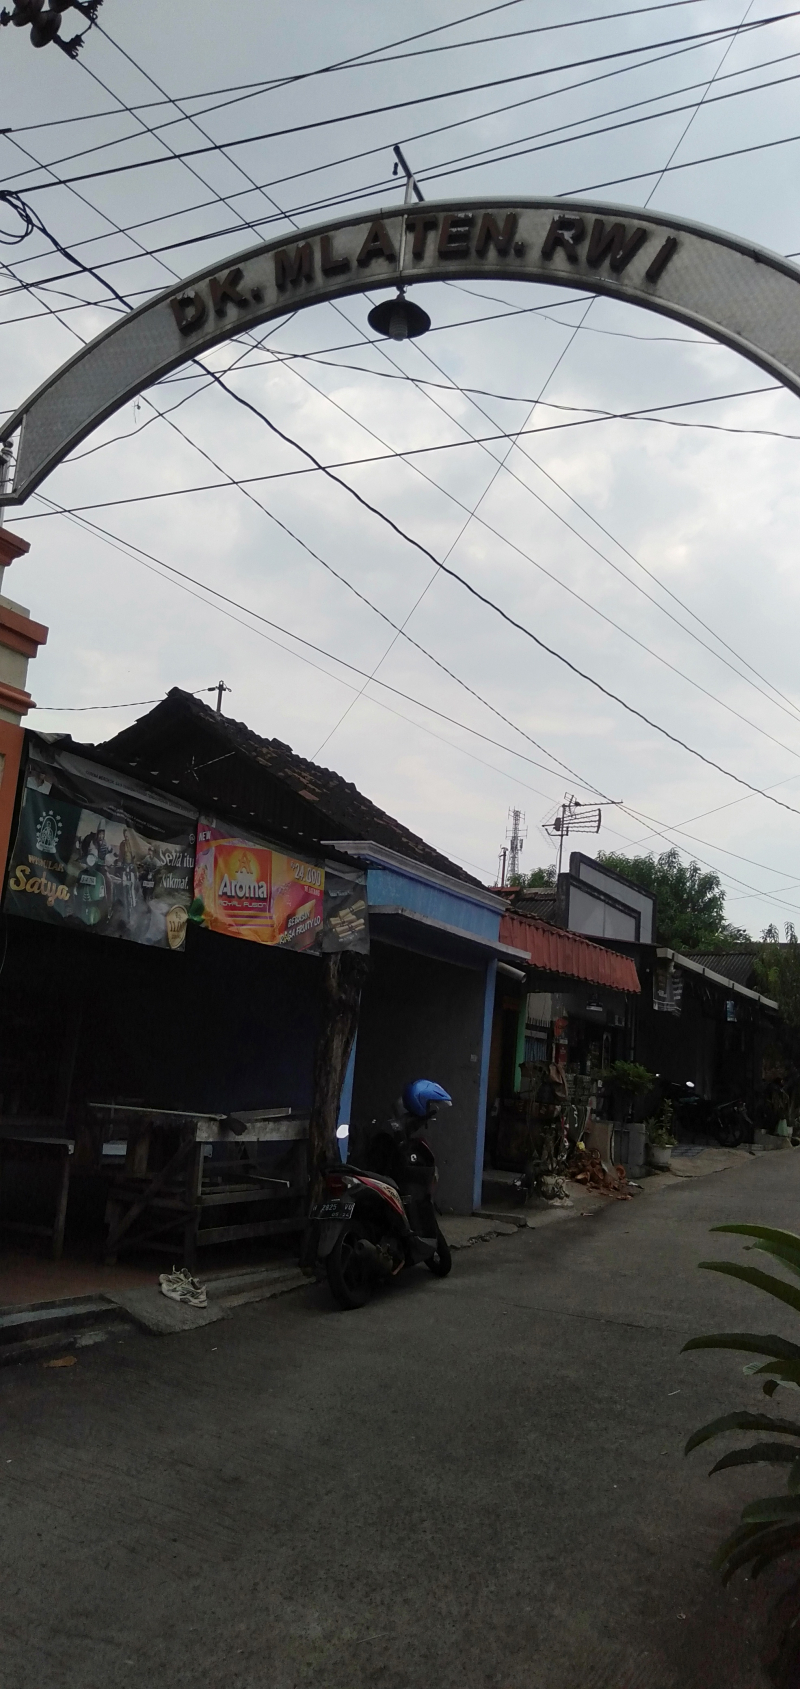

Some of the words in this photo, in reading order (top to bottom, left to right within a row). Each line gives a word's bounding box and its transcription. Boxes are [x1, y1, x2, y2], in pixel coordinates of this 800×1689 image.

[275, 213, 525, 290] MLATEN.
[198, 830, 212, 842] NEW
[183, 853, 195, 868] itu
[9, 864, 71, 907] Satya
[294, 863, 322, 886] 24.000
[218, 873, 267, 900] Aroma
[296, 919, 313, 936] FRUITY
